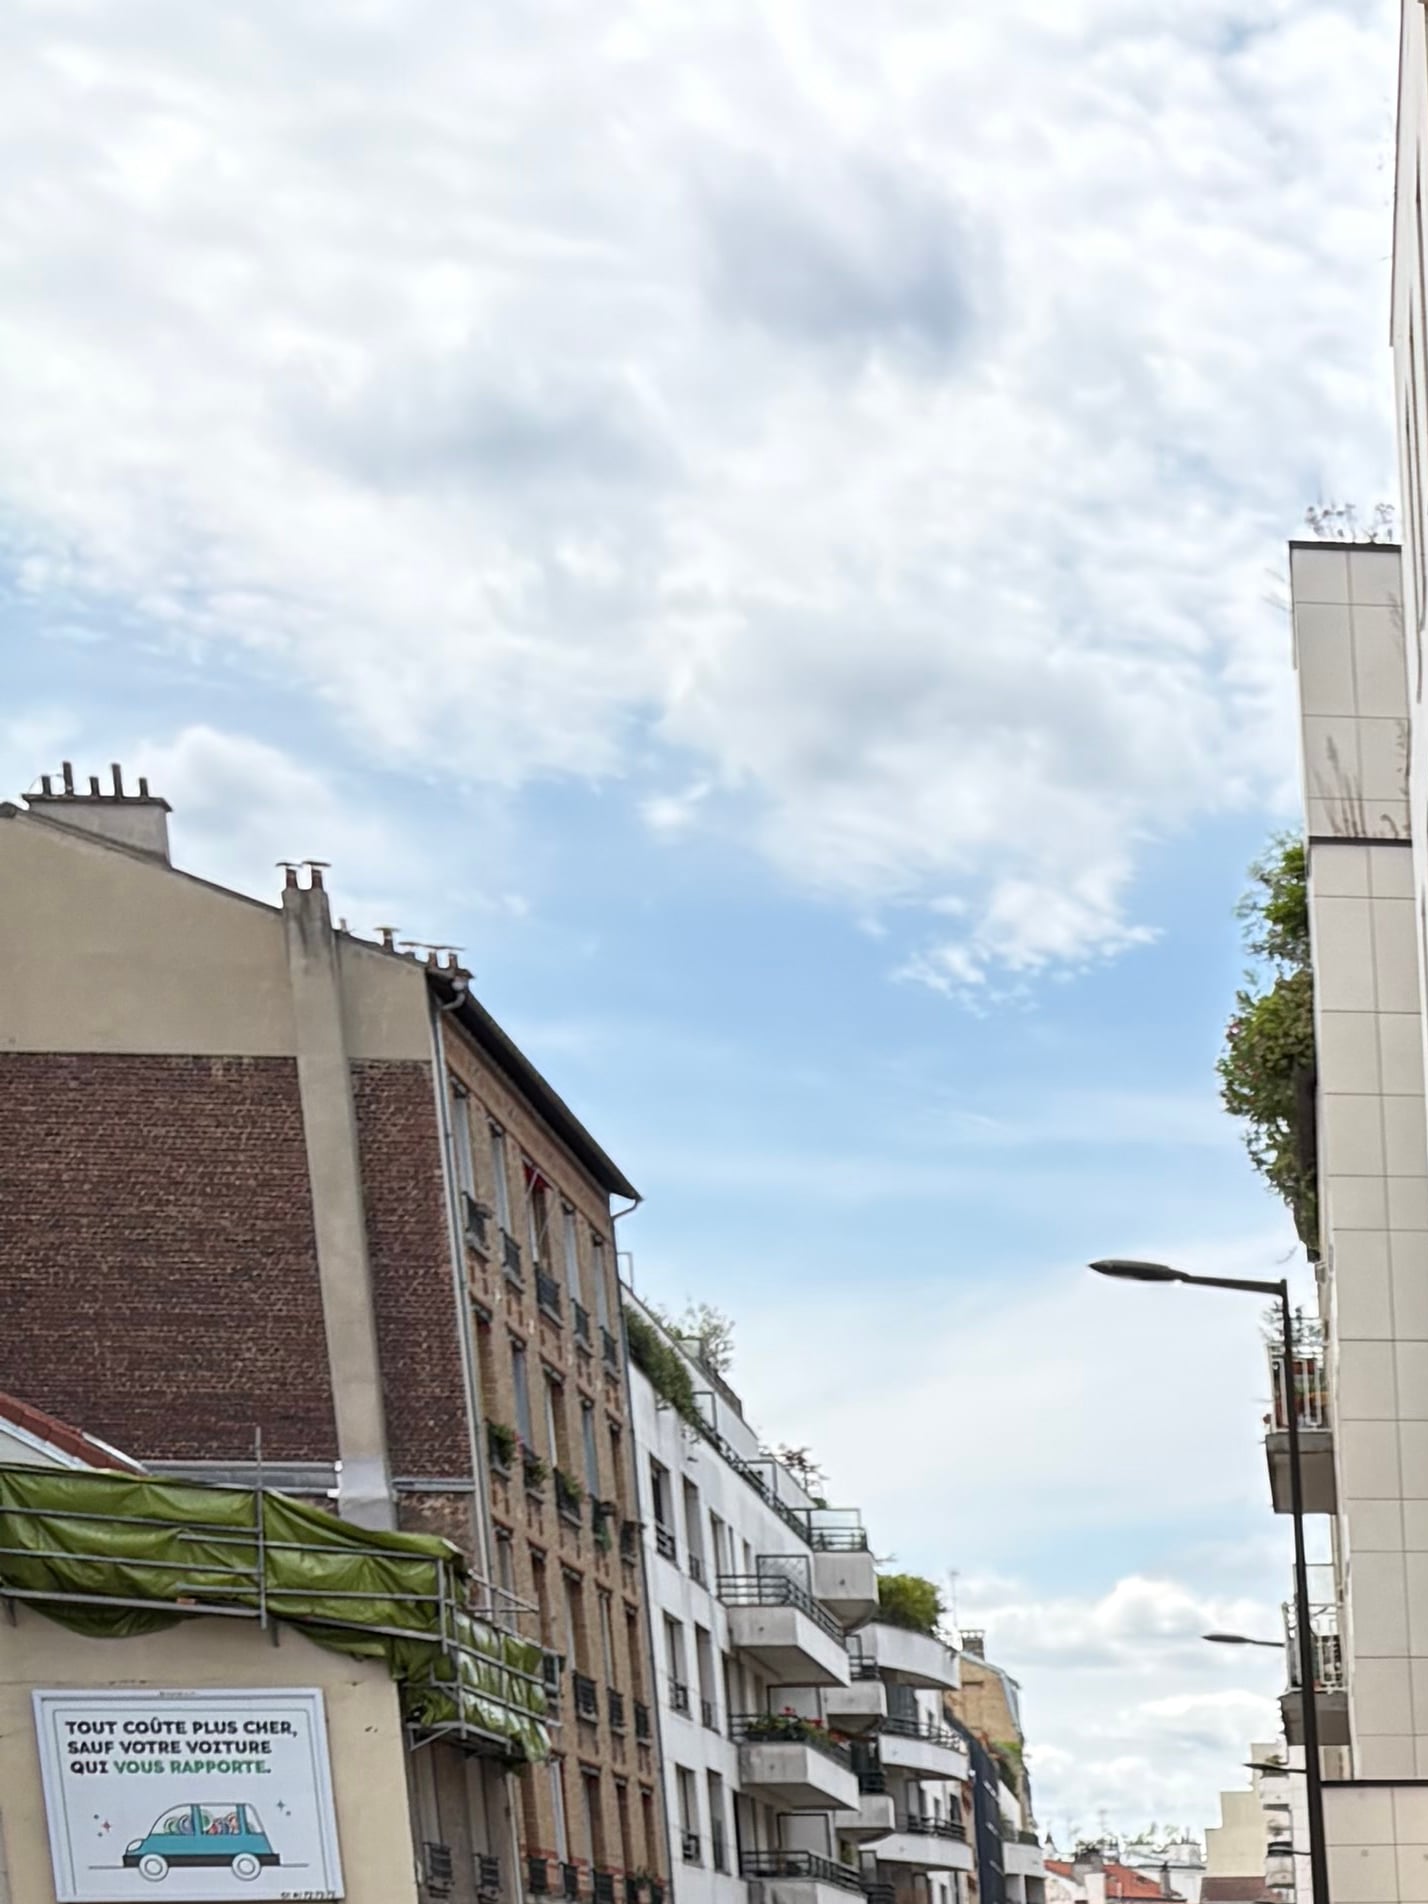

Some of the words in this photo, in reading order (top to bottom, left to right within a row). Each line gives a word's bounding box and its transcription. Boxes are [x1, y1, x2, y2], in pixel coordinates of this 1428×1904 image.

[65, 1720, 117, 1735] TOUT
[123, 1717, 187, 1735] COÛTE
[192, 1720, 238, 1735] PLUS
[243, 1720, 298, 1737] CHER,
[67, 1740, 115, 1754] SAUF
[120, 1740, 182, 1754] VOTRE
[189, 1740, 272, 1754] VOITURE
[70, 1760, 108, 1775] QUI
[114, 1760, 165, 1774] VOUS
[170, 1760, 272, 1774] RAPPORTE.
